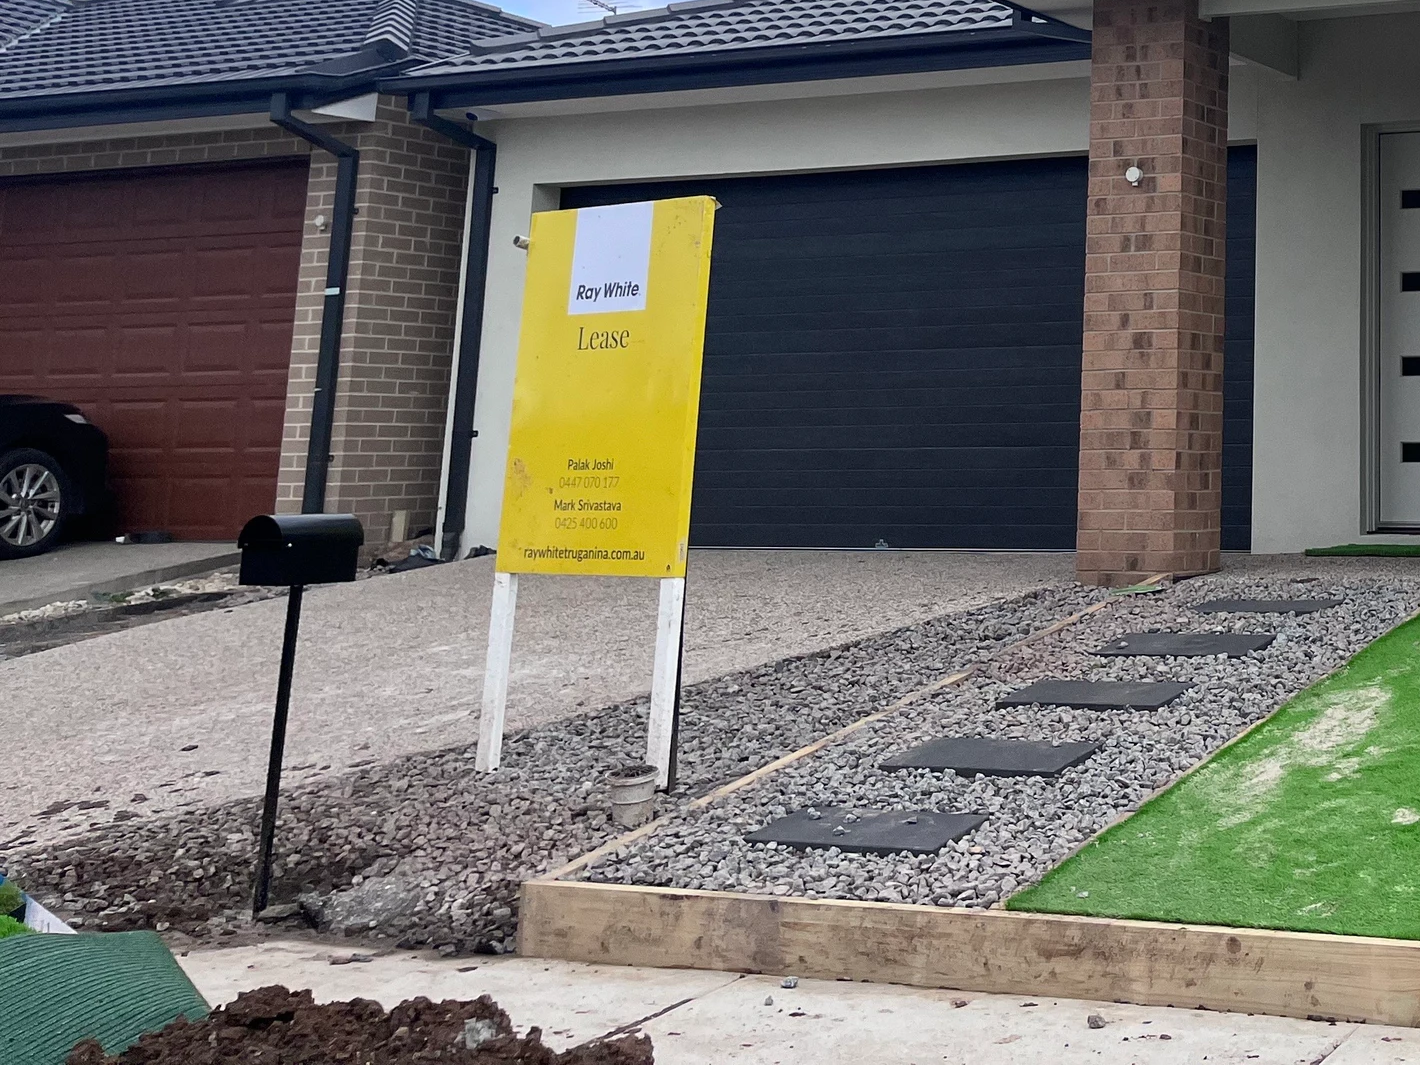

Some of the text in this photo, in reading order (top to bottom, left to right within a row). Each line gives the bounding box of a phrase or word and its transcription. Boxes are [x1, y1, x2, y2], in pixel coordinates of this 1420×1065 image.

[576, 281, 640, 302] Ray White
[577, 326, 630, 350] Lease
[567, 458, 614, 470] Palak Joshi
[559, 476, 620, 489] 0447 070 177
[554, 498, 622, 511] Mark Srivastava
[555, 517, 618, 530] 0425 400 600
[523, 545, 645, 562] raywhitetruganina.com.au
